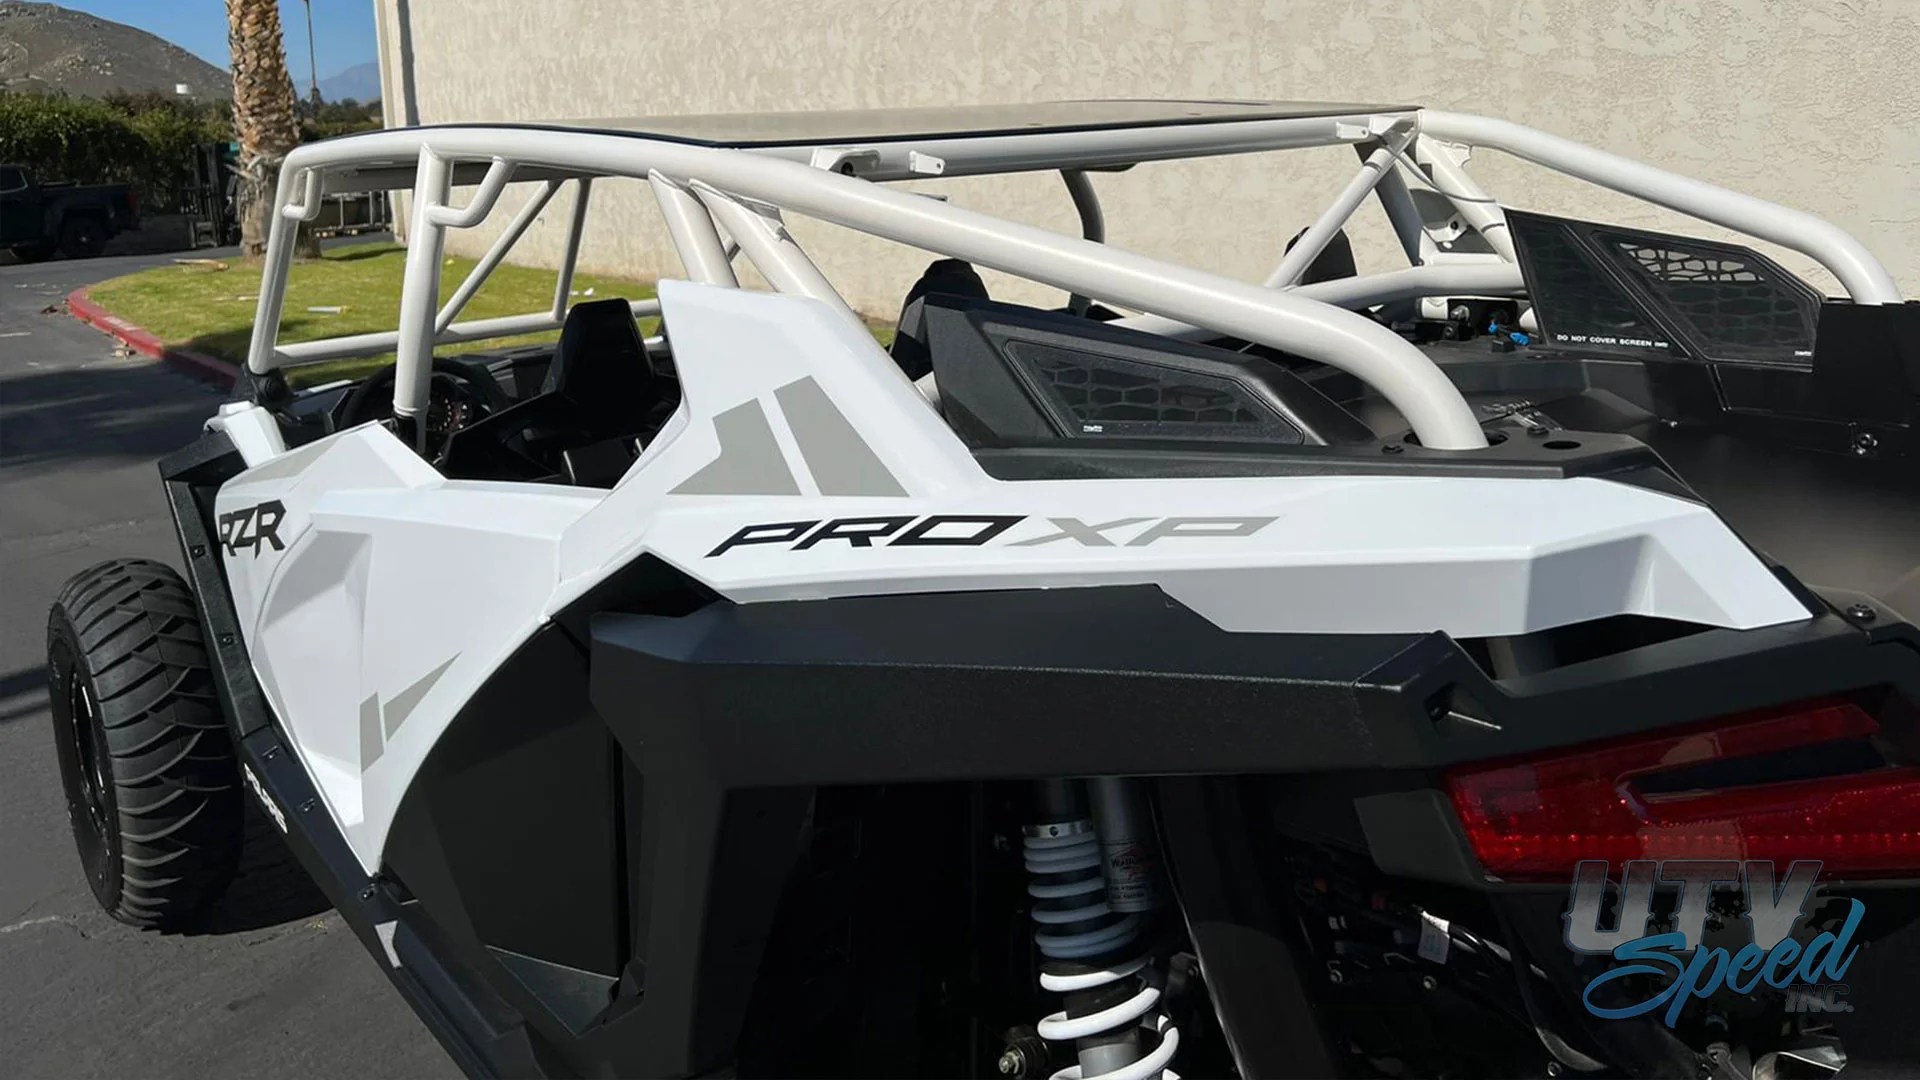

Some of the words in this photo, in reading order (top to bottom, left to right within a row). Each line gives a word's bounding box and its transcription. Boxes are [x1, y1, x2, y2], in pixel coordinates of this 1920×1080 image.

[1556, 333, 1569, 342] DO
[1571, 335, 1587, 343] NOT
[1589, 336, 1616, 345] COVER
[1619, 338, 1652, 347] SCREEN
[219, 499, 287, 560] RZR
[703, 515, 1029, 558] PRO
[1003, 516, 1280, 547] XP
